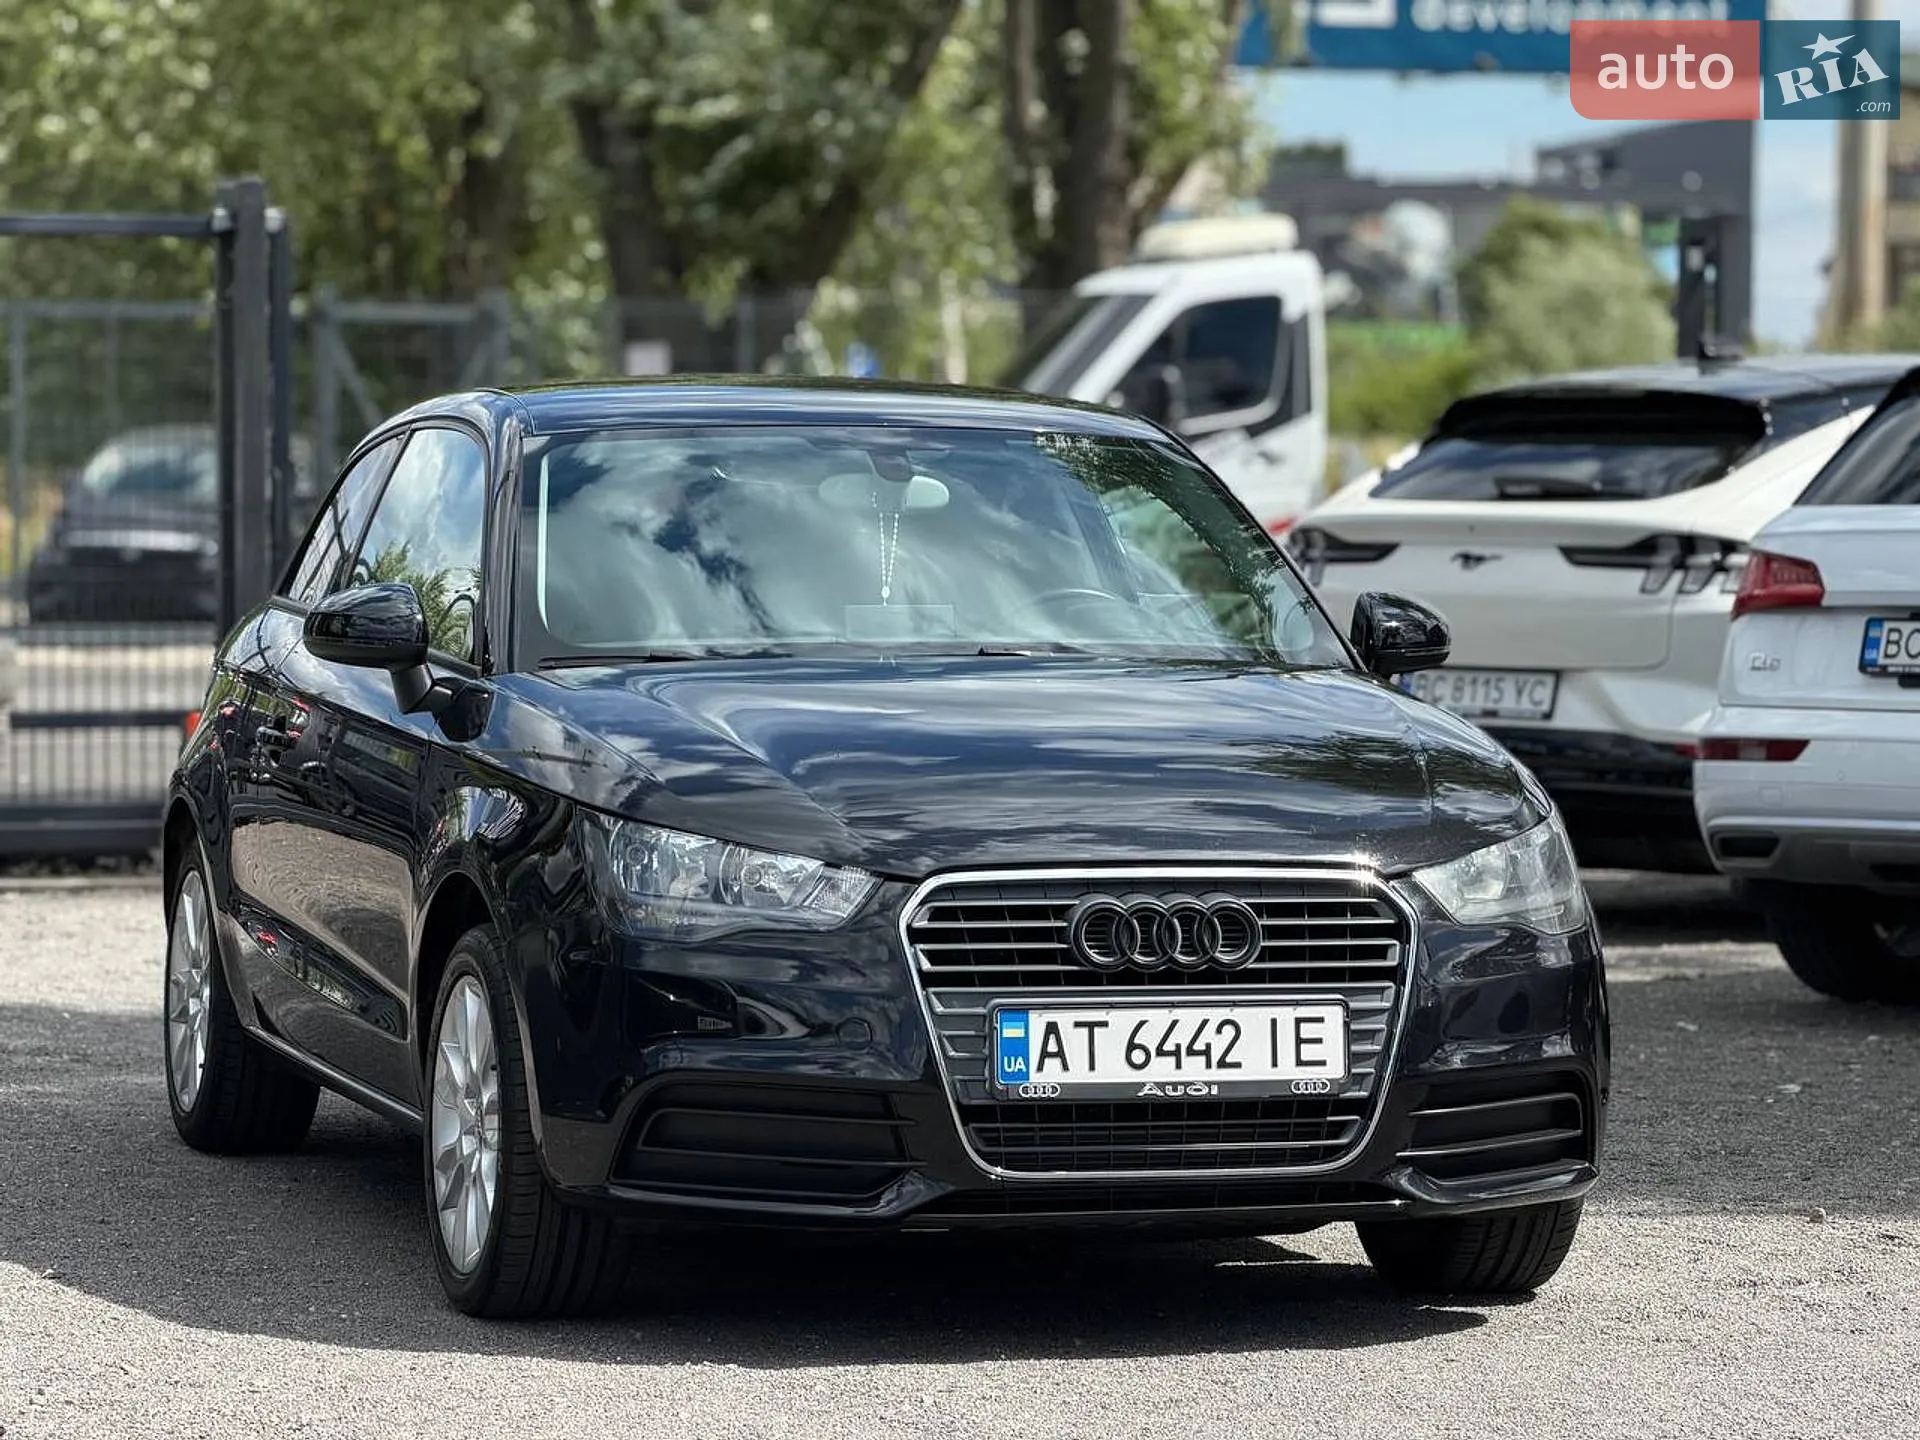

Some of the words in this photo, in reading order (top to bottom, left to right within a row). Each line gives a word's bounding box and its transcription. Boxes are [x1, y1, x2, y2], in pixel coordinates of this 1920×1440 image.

[1035, 1020, 1109, 1073] AT
[1124, 1018, 1242, 1071] 6442
[1270, 1016, 1327, 1068] IE
[1003, 1058, 1027, 1073] UA
